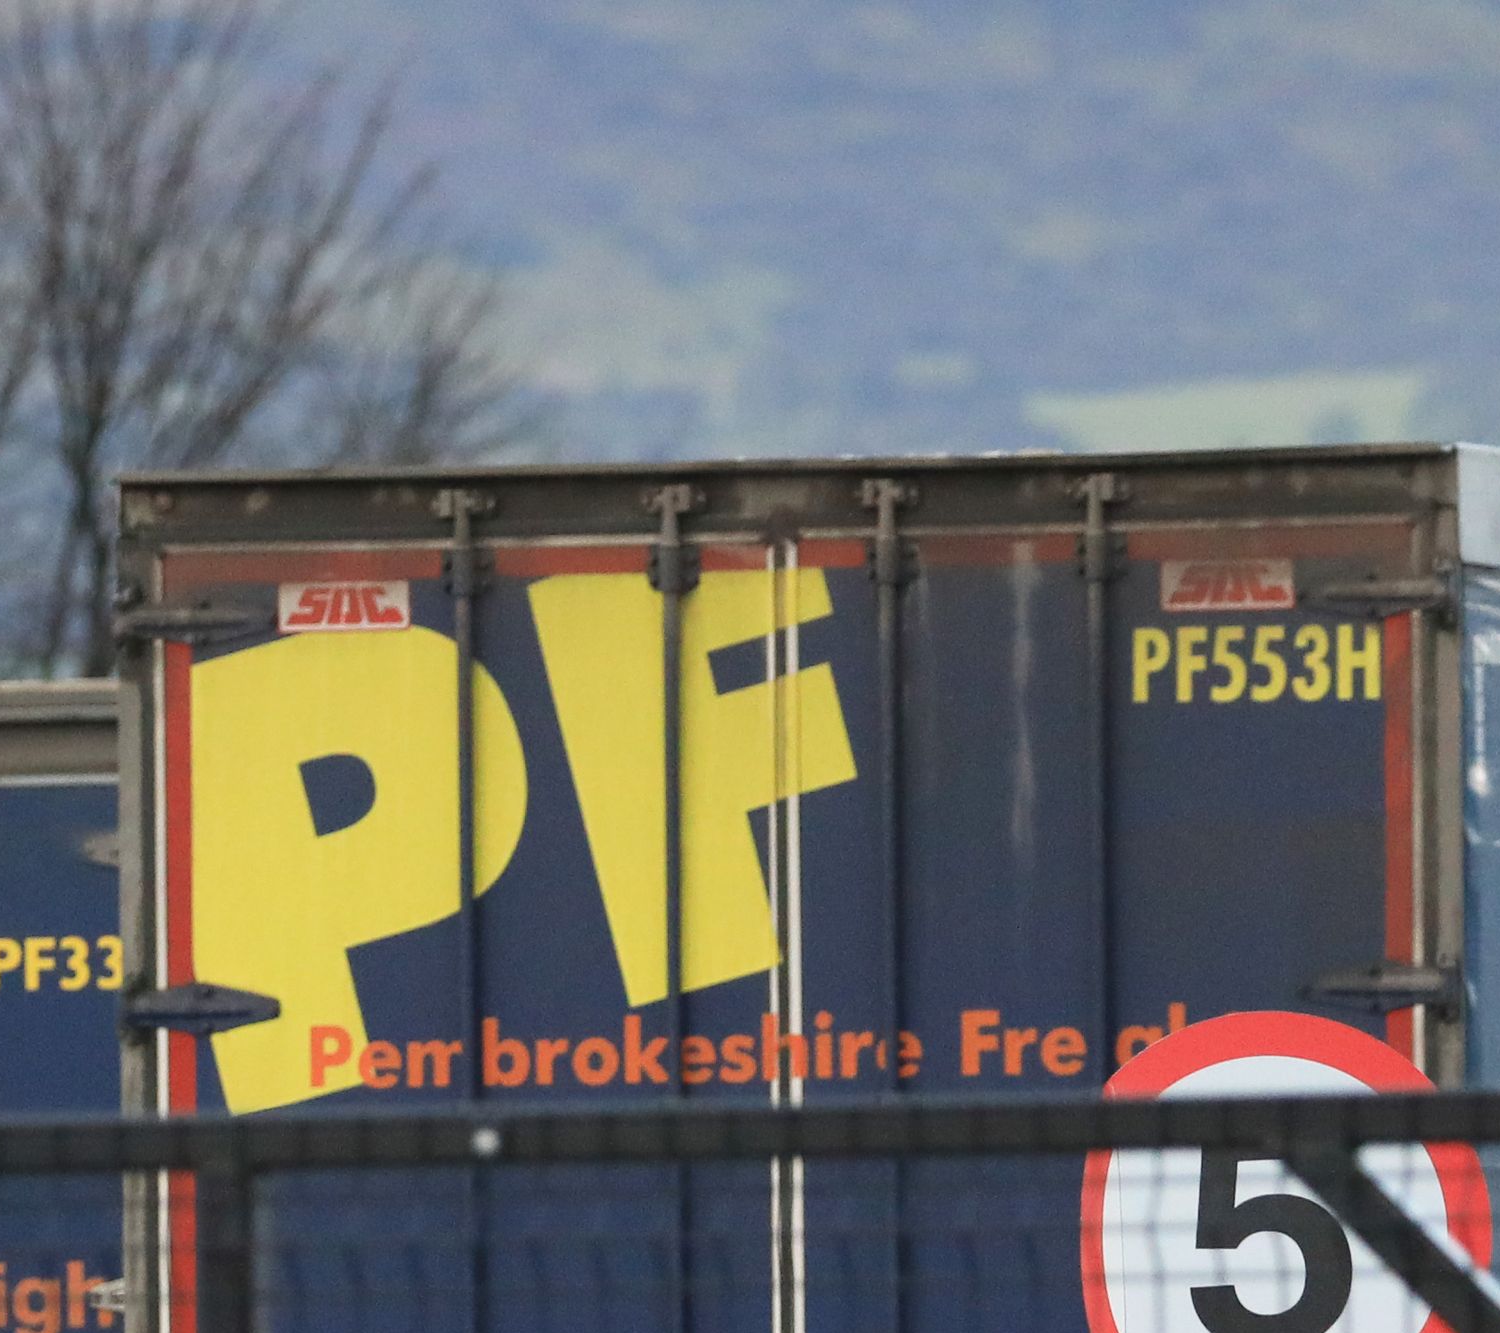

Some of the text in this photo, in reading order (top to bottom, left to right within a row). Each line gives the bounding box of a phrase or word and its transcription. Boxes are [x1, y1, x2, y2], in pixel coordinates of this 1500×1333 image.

[1131, 622, 1382, 703] PF553H
[191, 567, 858, 1117] PF
[308, 1009, 923, 1090] Pembrokeshire
